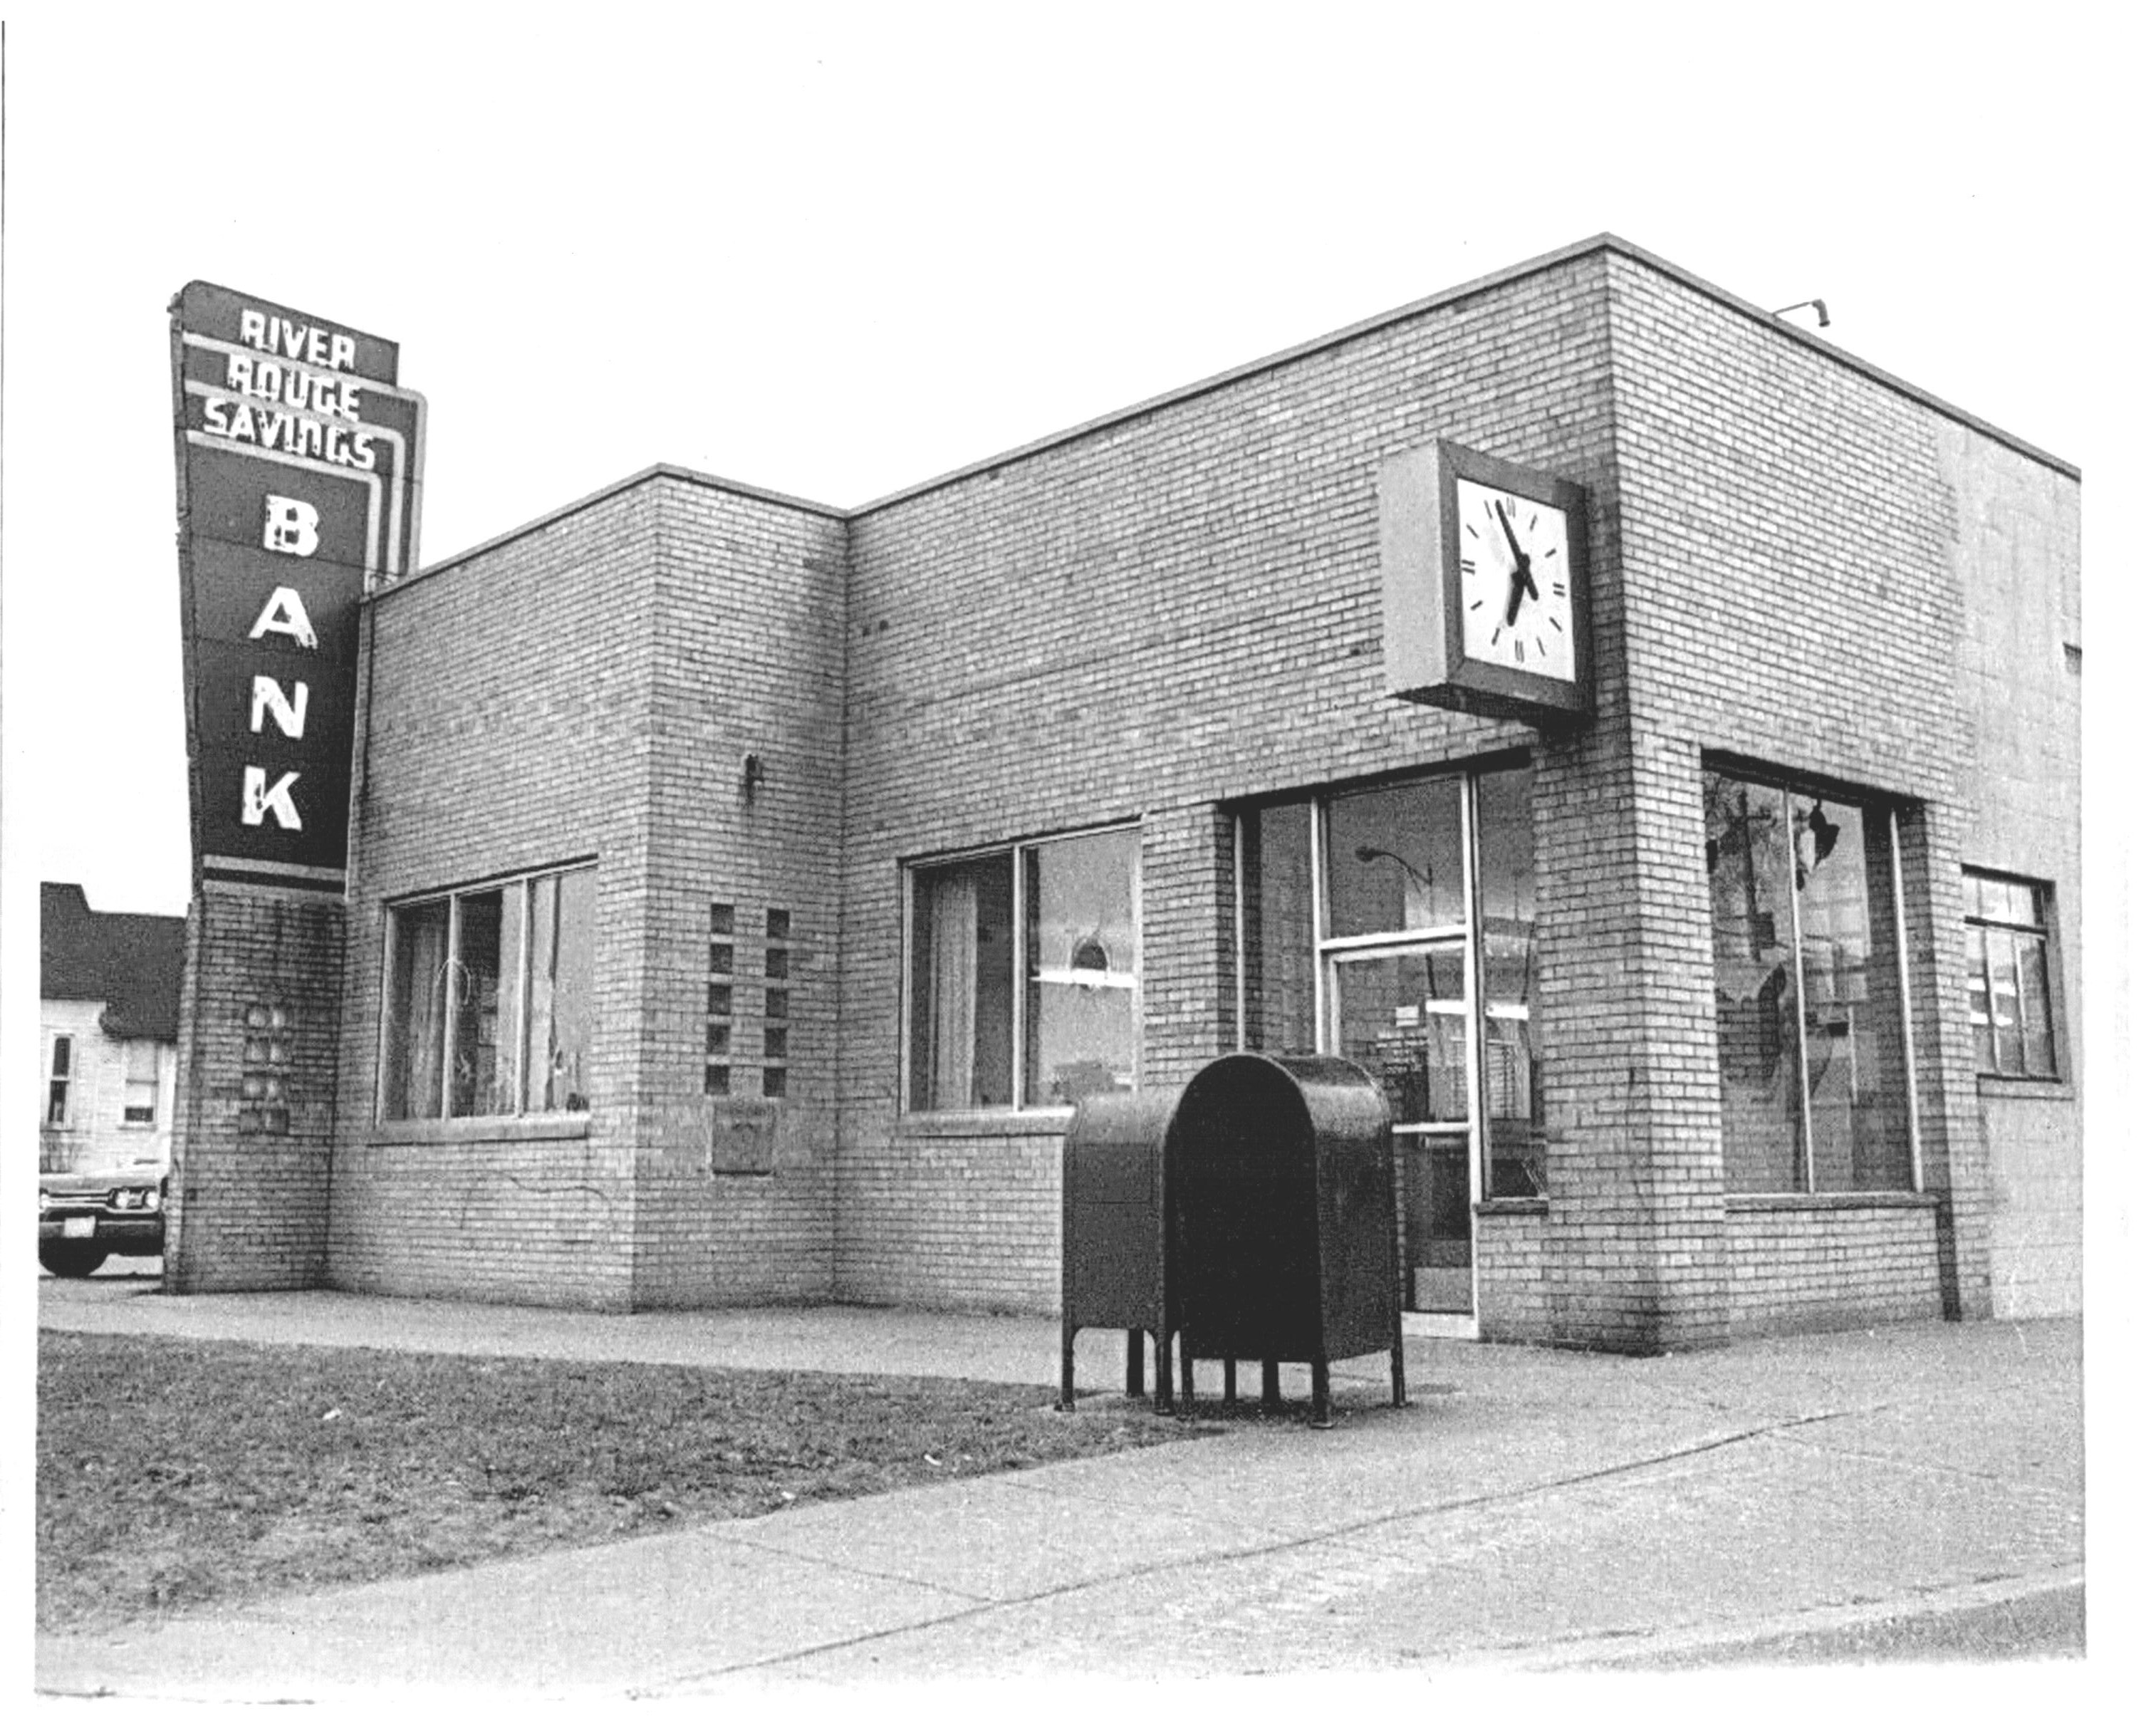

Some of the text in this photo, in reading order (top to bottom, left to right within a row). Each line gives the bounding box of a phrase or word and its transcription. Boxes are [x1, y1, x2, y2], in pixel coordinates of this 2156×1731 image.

[239, 309, 356, 370] RIVER
[227, 354, 360, 423] ROUGE
[204, 397, 376, 470] SAVINGS
[242, 493, 319, 831] BANK
